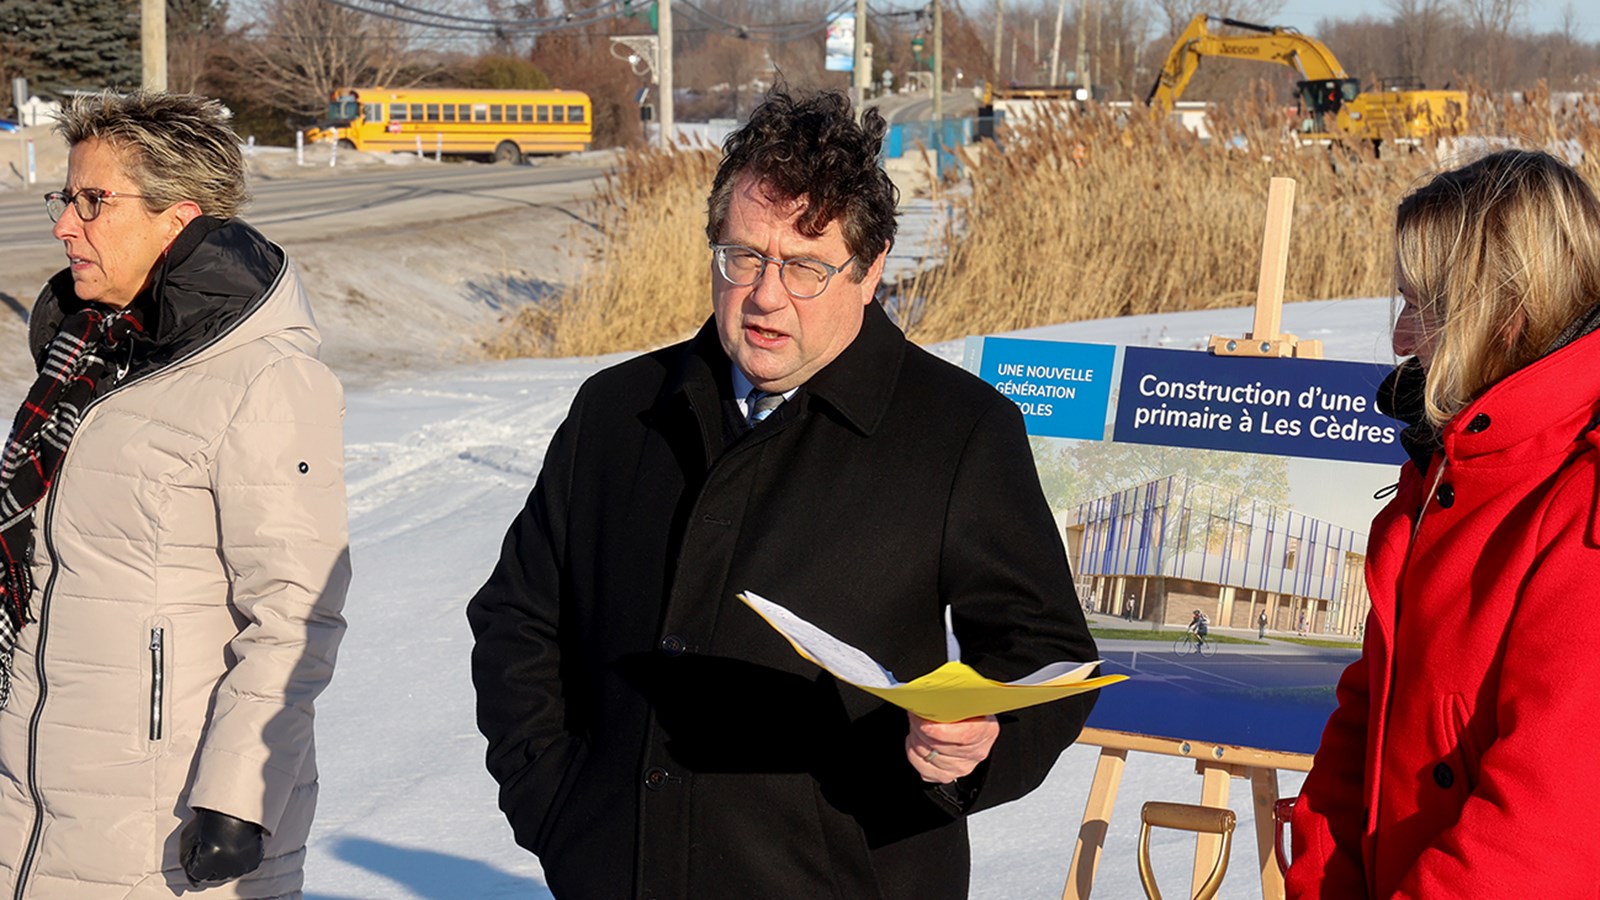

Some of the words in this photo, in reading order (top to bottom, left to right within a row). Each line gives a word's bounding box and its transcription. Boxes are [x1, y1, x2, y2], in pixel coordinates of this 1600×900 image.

[997, 363, 1025, 377] UNE
[1026, 365, 1094, 382] NOUVELLE
[995, 380, 1076, 399] GÉNÉRATION
[1139, 374, 1291, 407] Construction
[1298, 386, 1367, 413] d'une
[1134, 403, 1232, 431] primaire
[1238, 408, 1253, 433] à
[1260, 411, 1301, 436] Les
[1309, 415, 1395, 444] Cèdres
